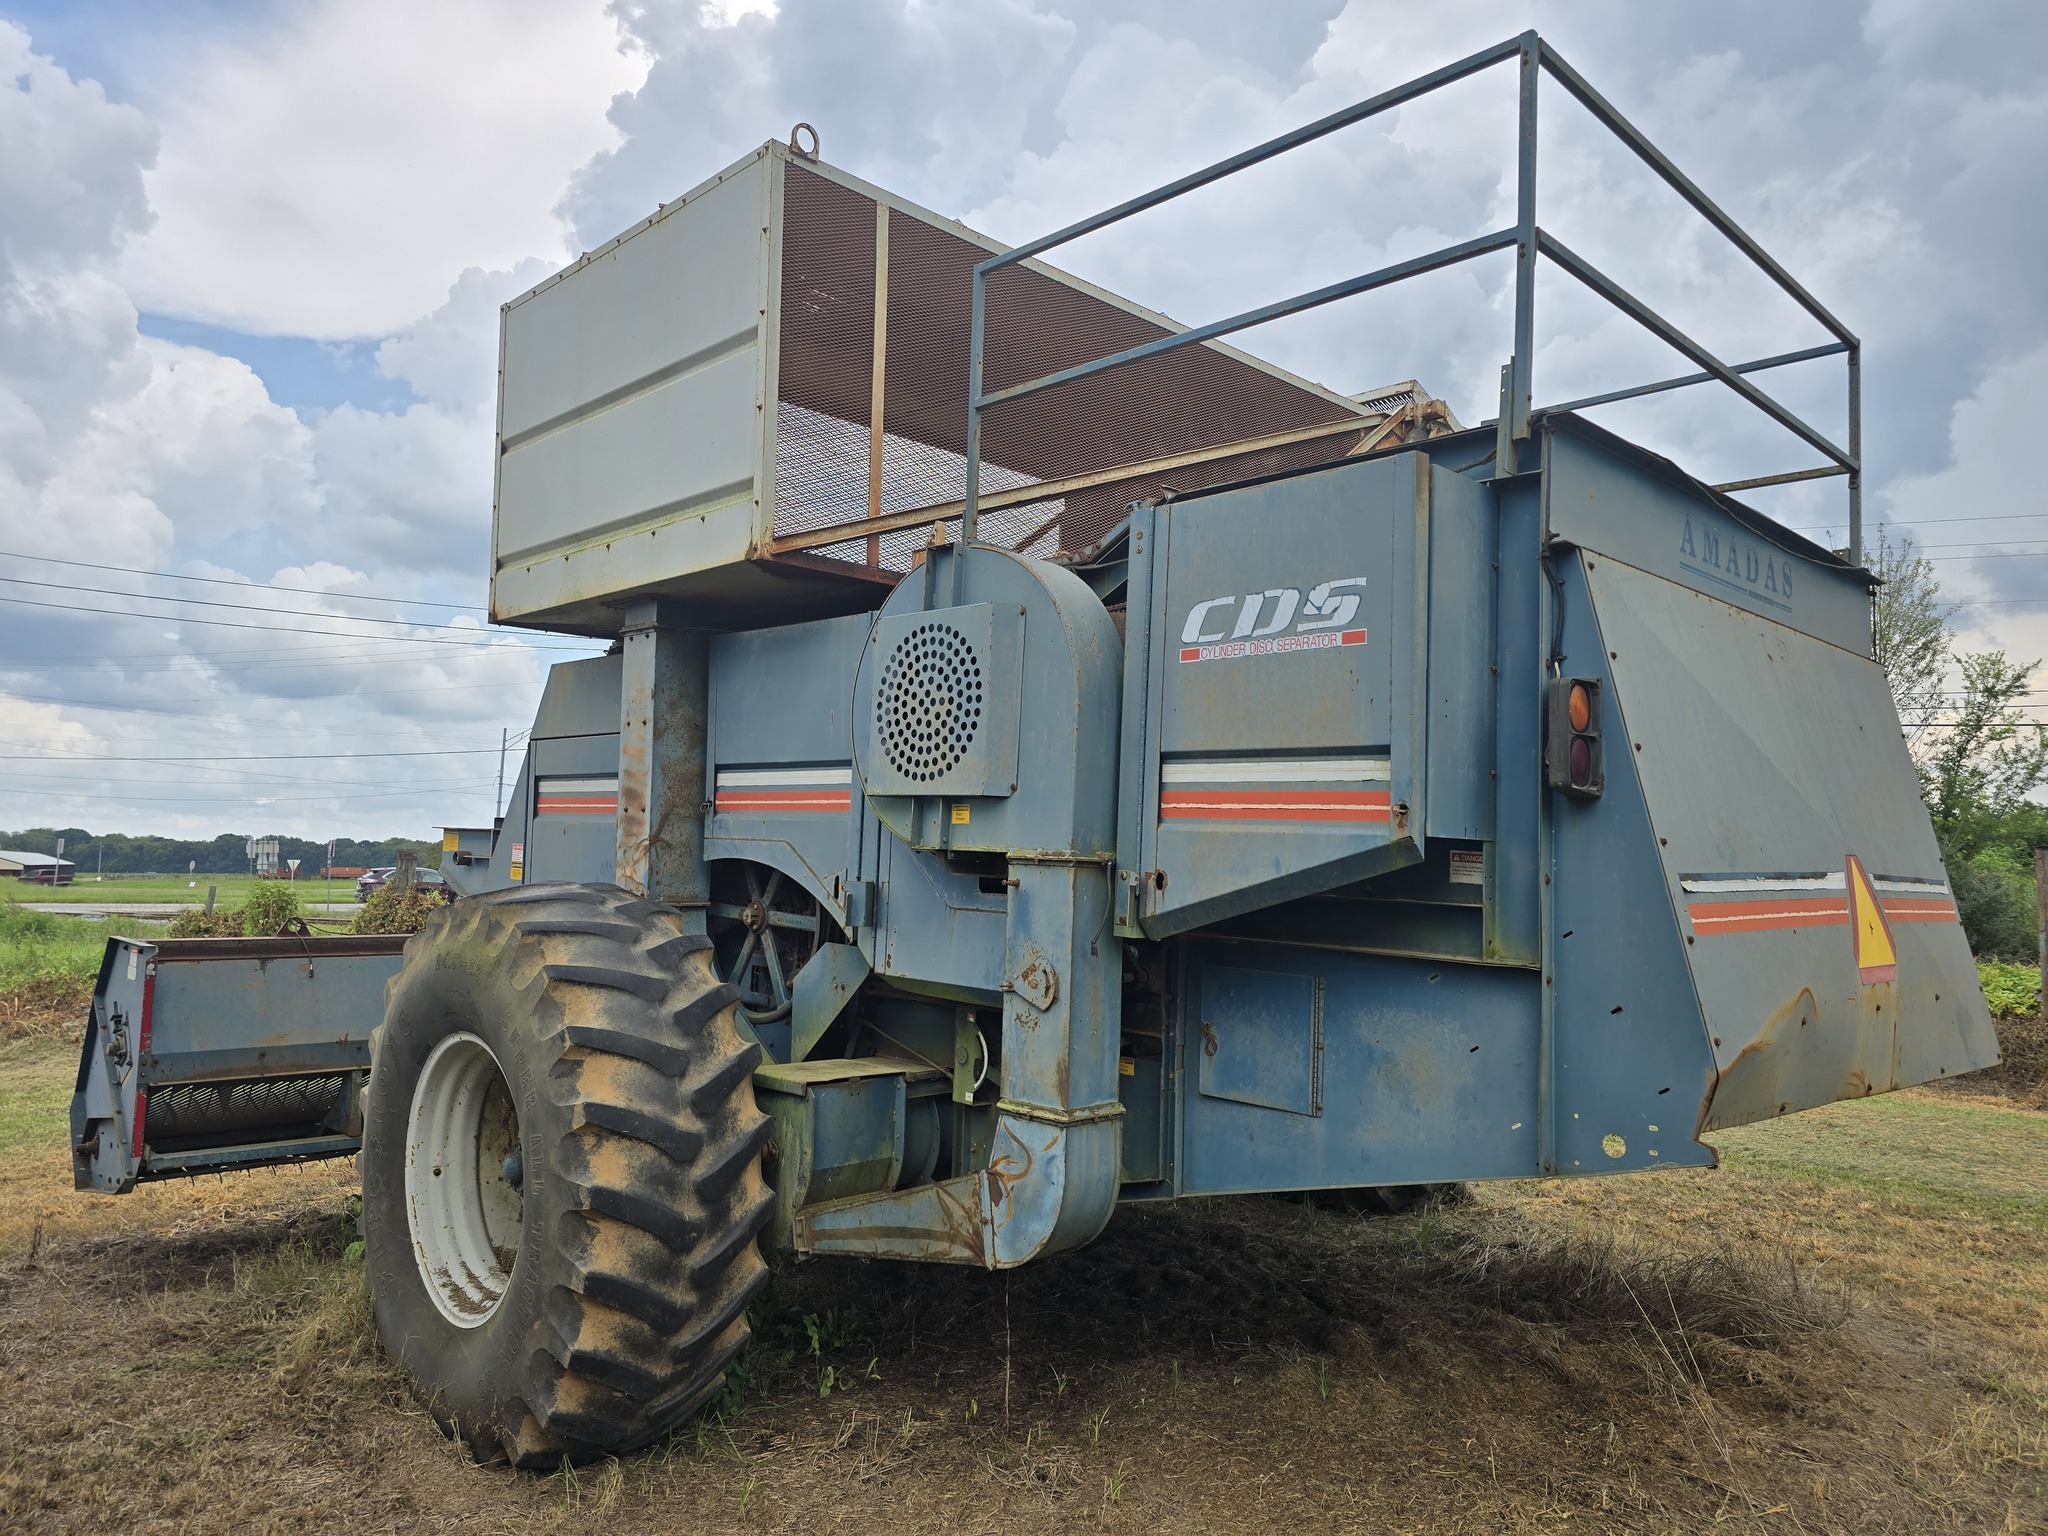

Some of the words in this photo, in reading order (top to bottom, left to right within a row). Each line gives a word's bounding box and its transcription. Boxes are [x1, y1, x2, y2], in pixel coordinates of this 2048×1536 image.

[1680, 514, 1793, 599] AMADAS
[1180, 577, 1368, 644] CDS
[1200, 642, 1247, 660] CYLINDER
[1250, 640, 1273, 655] DISC
[1276, 633, 1338, 652] SEPARATOR
[1462, 854, 1483, 862] DANGE
[502, 1010, 537, 1112] SUPER
[530, 1134, 545, 1197] ALL
[499, 1220, 544, 1372] TRACTION
